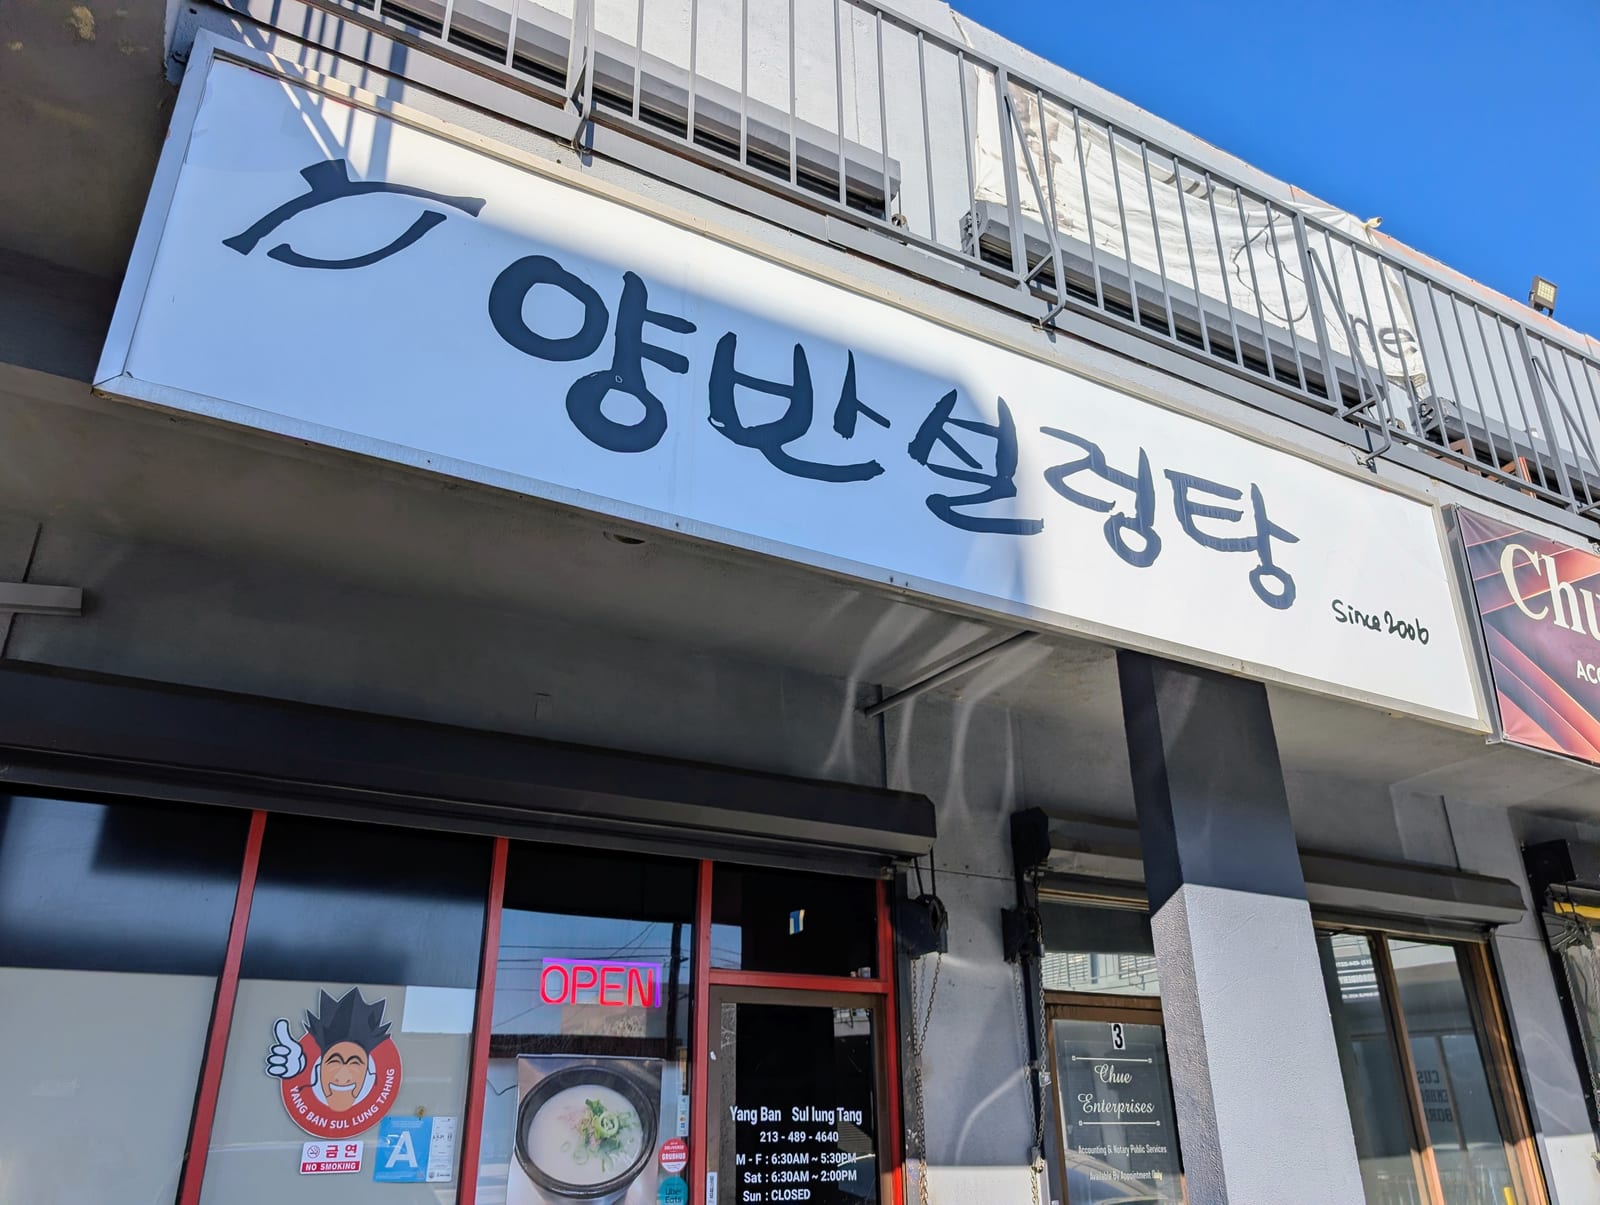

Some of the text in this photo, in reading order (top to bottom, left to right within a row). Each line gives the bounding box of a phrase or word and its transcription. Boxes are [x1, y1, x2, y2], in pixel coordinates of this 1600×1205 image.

[1331, 598, 1382, 632] Since
[539, 963, 654, 1009] OPEN
[1112, 1023, 1123, 1049] 3
[1094, 1063, 1133, 1084] Chue
[289, 1068, 396, 1129] YANG BAN SUL LUNG TAHNG
[1077, 1093, 1155, 1120] Enterprises
[729, 1105, 863, 1125] Yang Ban Sul lung Tang
[384, 1130, 418, 1169] A
[771, 1153, 809, 1165] 6:30AM
[820, 1152, 857, 1164] 5:30PM
[1078, 1144, 1107, 1156] Accounting
[1113, 1144, 1130, 1157] Notary
[1130, 1144, 1145, 1154] Public
[1145, 1144, 1168, 1154] Services
[304, 1162, 356, 1171] NO SMOKING
[770, 1170, 809, 1182] 6:30AM
[820, 1169, 857, 1181] 2:00PM
[770, 1189, 811, 1201] CLOSED
